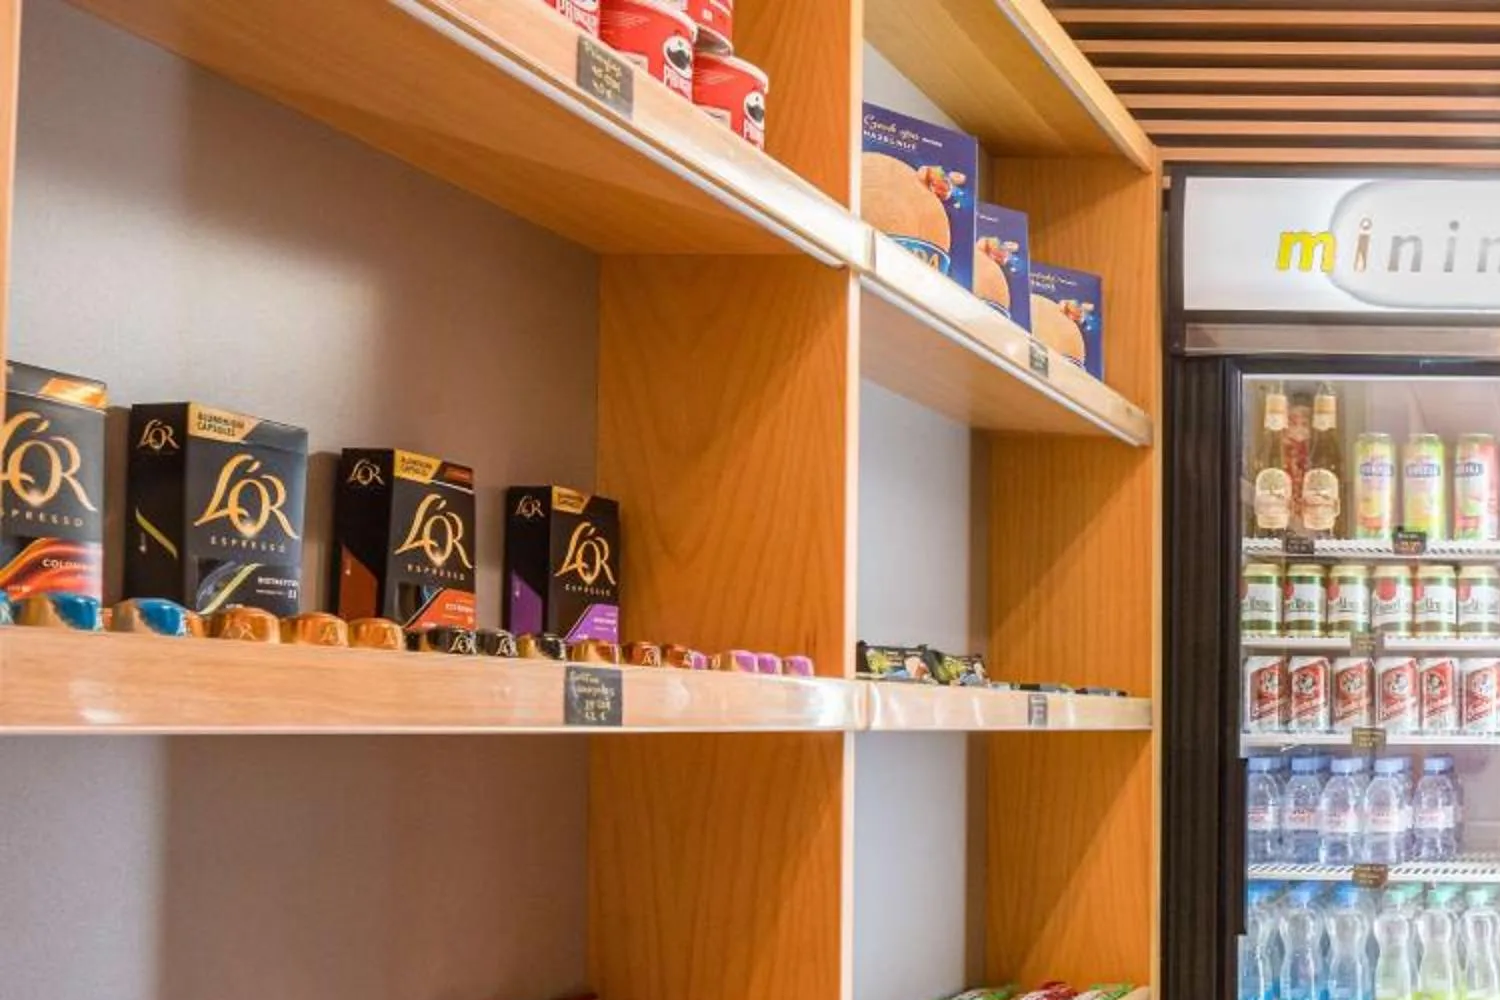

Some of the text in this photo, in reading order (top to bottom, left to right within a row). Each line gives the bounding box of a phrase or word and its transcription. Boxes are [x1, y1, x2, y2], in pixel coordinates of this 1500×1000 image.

[0, 509, 84, 528] SPRESSO
[210, 535, 286, 554] ESPRESSO
[407, 563, 465, 582] ESPRESSO
